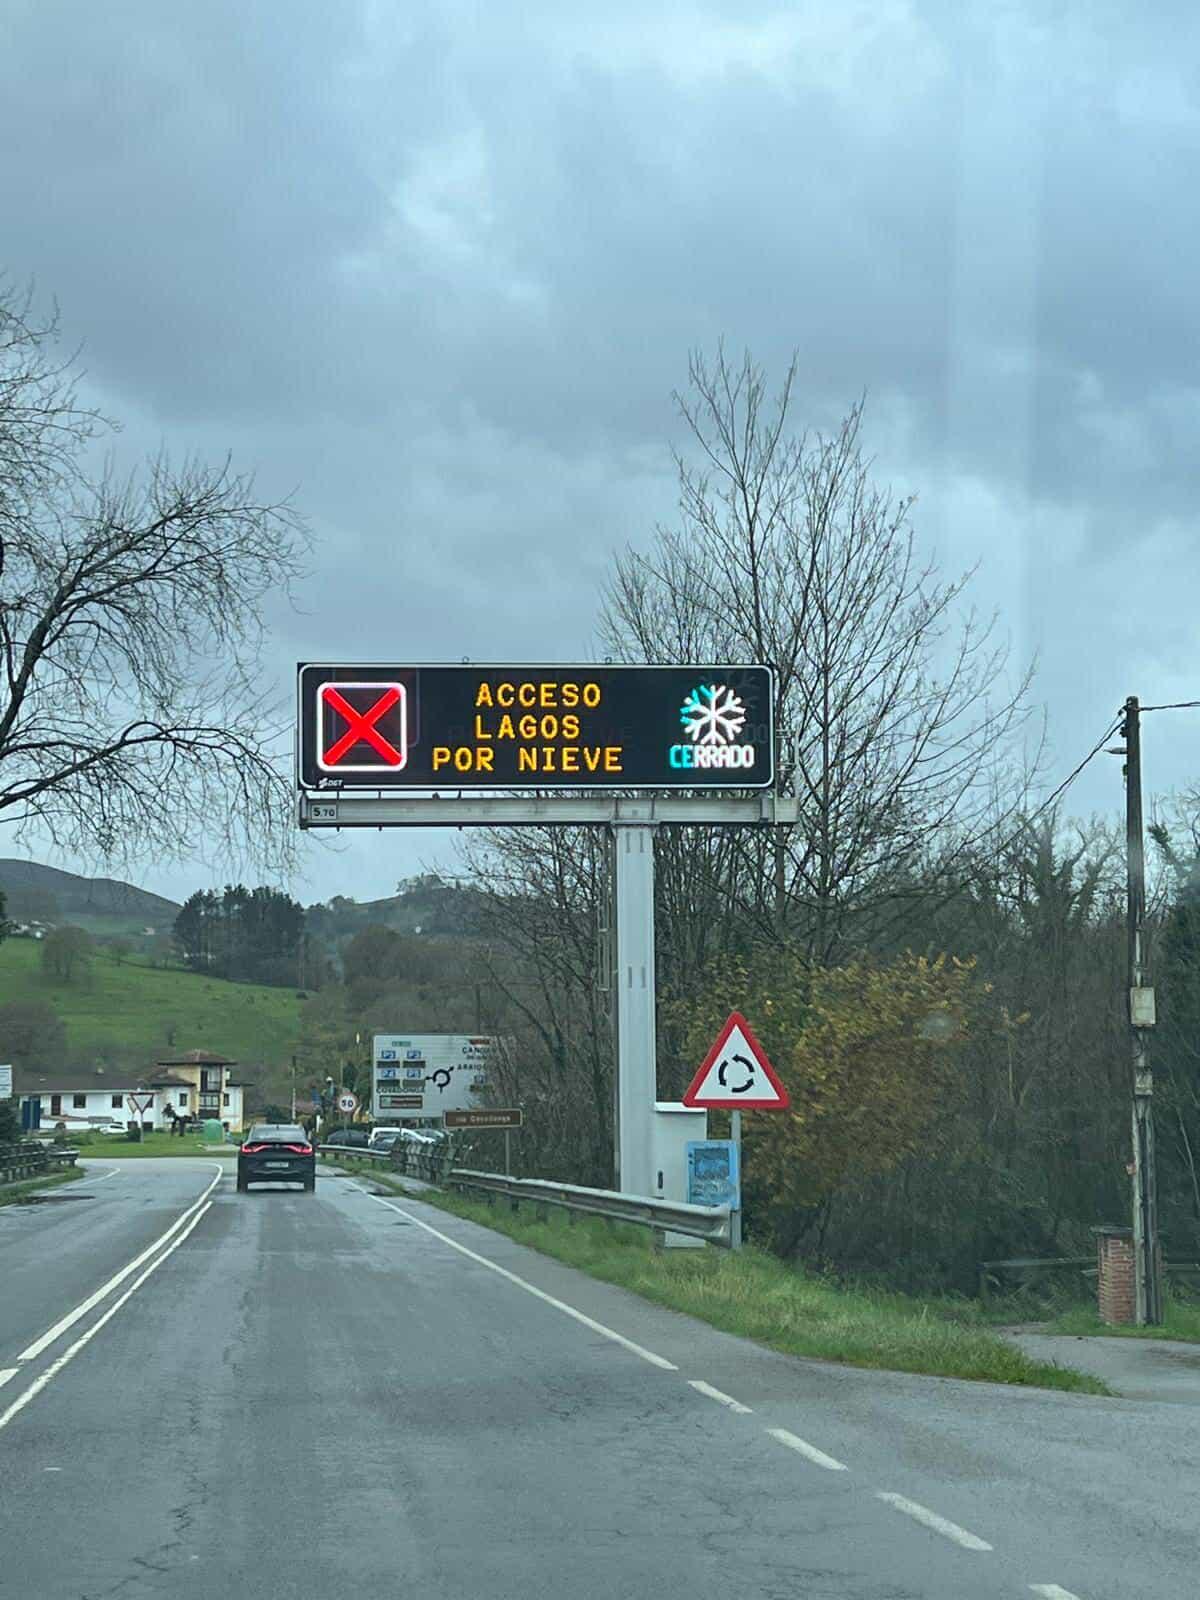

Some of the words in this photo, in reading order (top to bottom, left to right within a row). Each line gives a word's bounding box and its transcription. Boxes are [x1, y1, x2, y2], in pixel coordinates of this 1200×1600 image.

[475, 682, 601, 707] ACCESO
[475, 714, 580, 739] LAGOS
[432, 747, 493, 771] POR
[518, 747, 623, 771] NIEVE
[669, 744, 755, 768] CERRADO
[340, 1099, 354, 1108] 50
